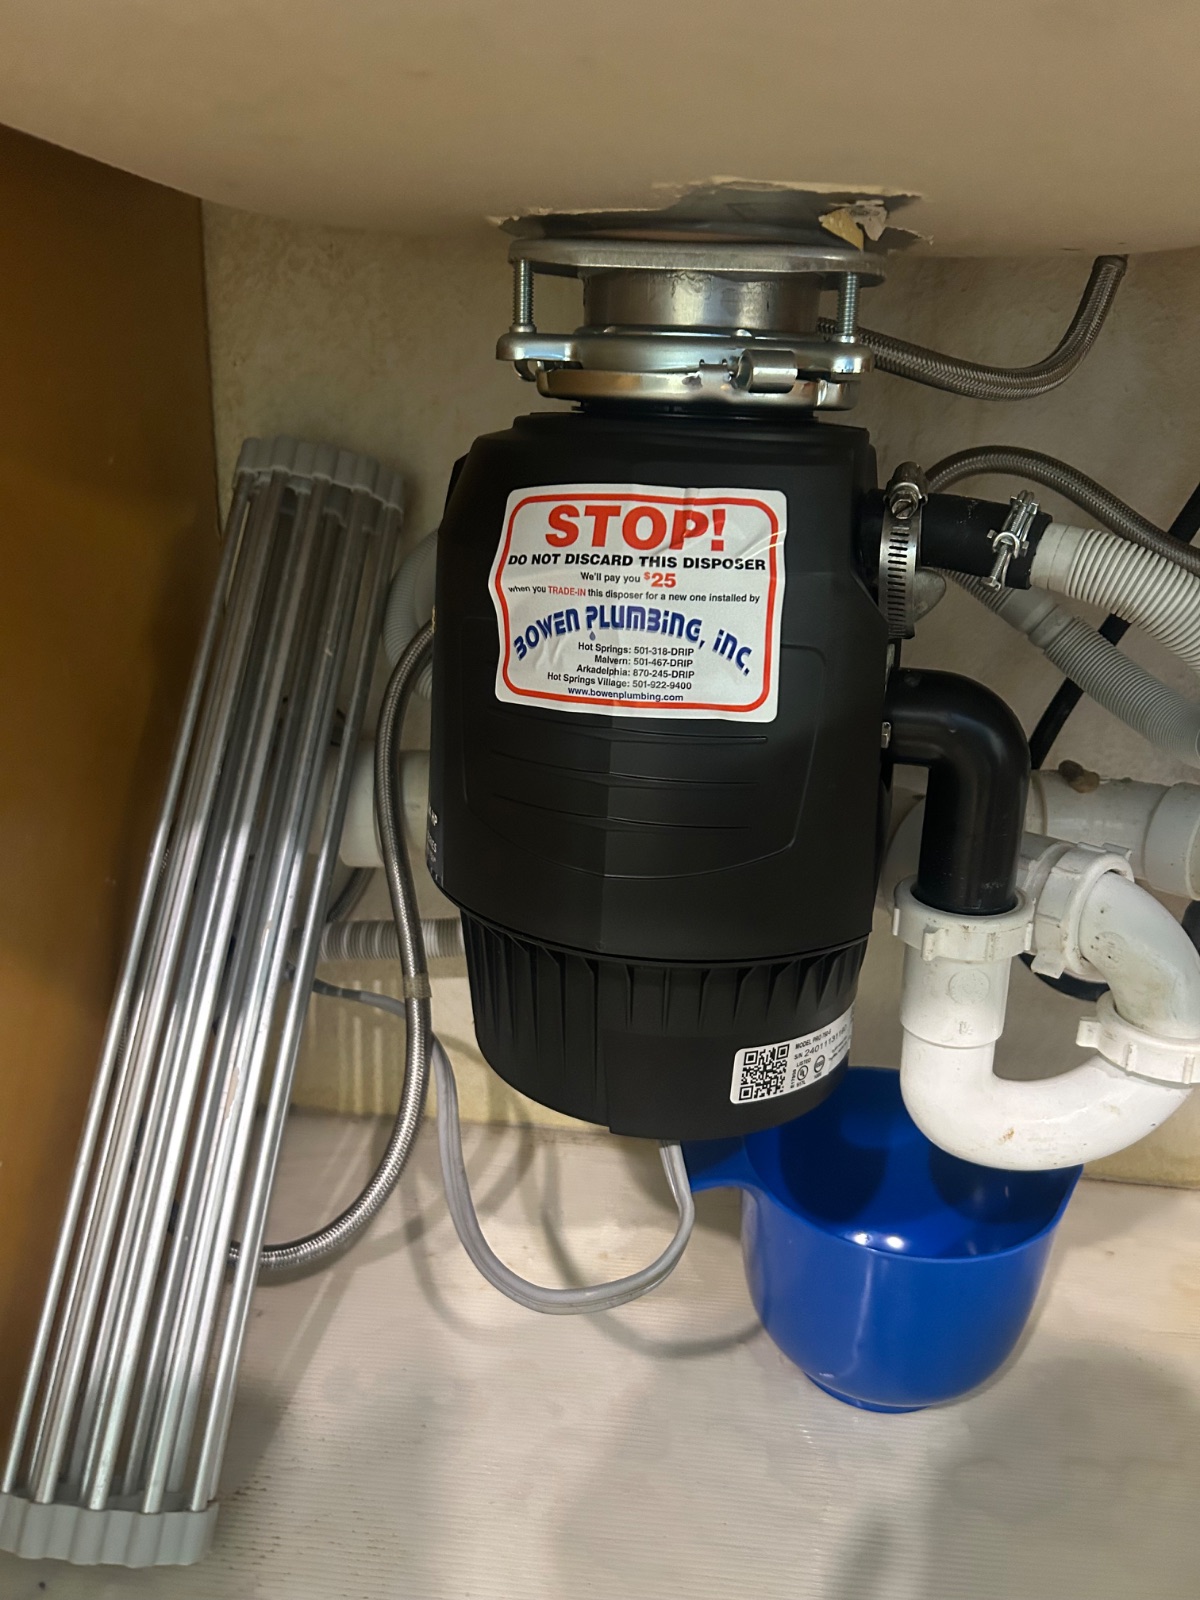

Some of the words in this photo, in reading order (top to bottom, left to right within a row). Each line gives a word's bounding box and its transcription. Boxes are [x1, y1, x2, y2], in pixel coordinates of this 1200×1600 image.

[546, 504, 726, 552] STOP!
[508, 555, 528, 565] DO
[532, 554, 561, 565] NOT
[564, 554, 633, 566] DISCARD
[640, 556, 678, 568] THIS
[683, 558, 766, 571] DISPOSER
[580, 572, 602, 582] We'll
[604, 574, 620, 585] pay
[623, 574, 640, 584] you
[644, 572, 676, 588] $25
[508, 585, 531, 593] when
[532, 586, 546, 594] you
[548, 586, 586, 597] TRADE-IN
[588, 588, 604, 598] this
[605, 590, 643, 601] disposer
[645, 592, 658, 600] for
[689, 594, 706, 602] one
[709, 593, 747, 603] installed
[749, 594, 760, 604] by
[578, 642, 594, 652] Hot
[595, 645, 632, 656] Springs:
[634, 646, 694, 656] 501-318-DRIP
[594, 655, 631, 666] Malvern:
[634, 658, 693, 668] 501-467-DRIP
[576, 664, 631, 677] Arkadelphia:
[633, 669, 695, 678] 870-245-DRIP
[548, 672, 563, 682] Hot
[564, 674, 596, 687] Springs
[597, 676, 630, 689] Village:
[632, 679, 692, 690] 501-922-9400
[568, 688, 684, 702] www.bowenplumbing.com
[796, 1040, 811, 1049] MODEL
